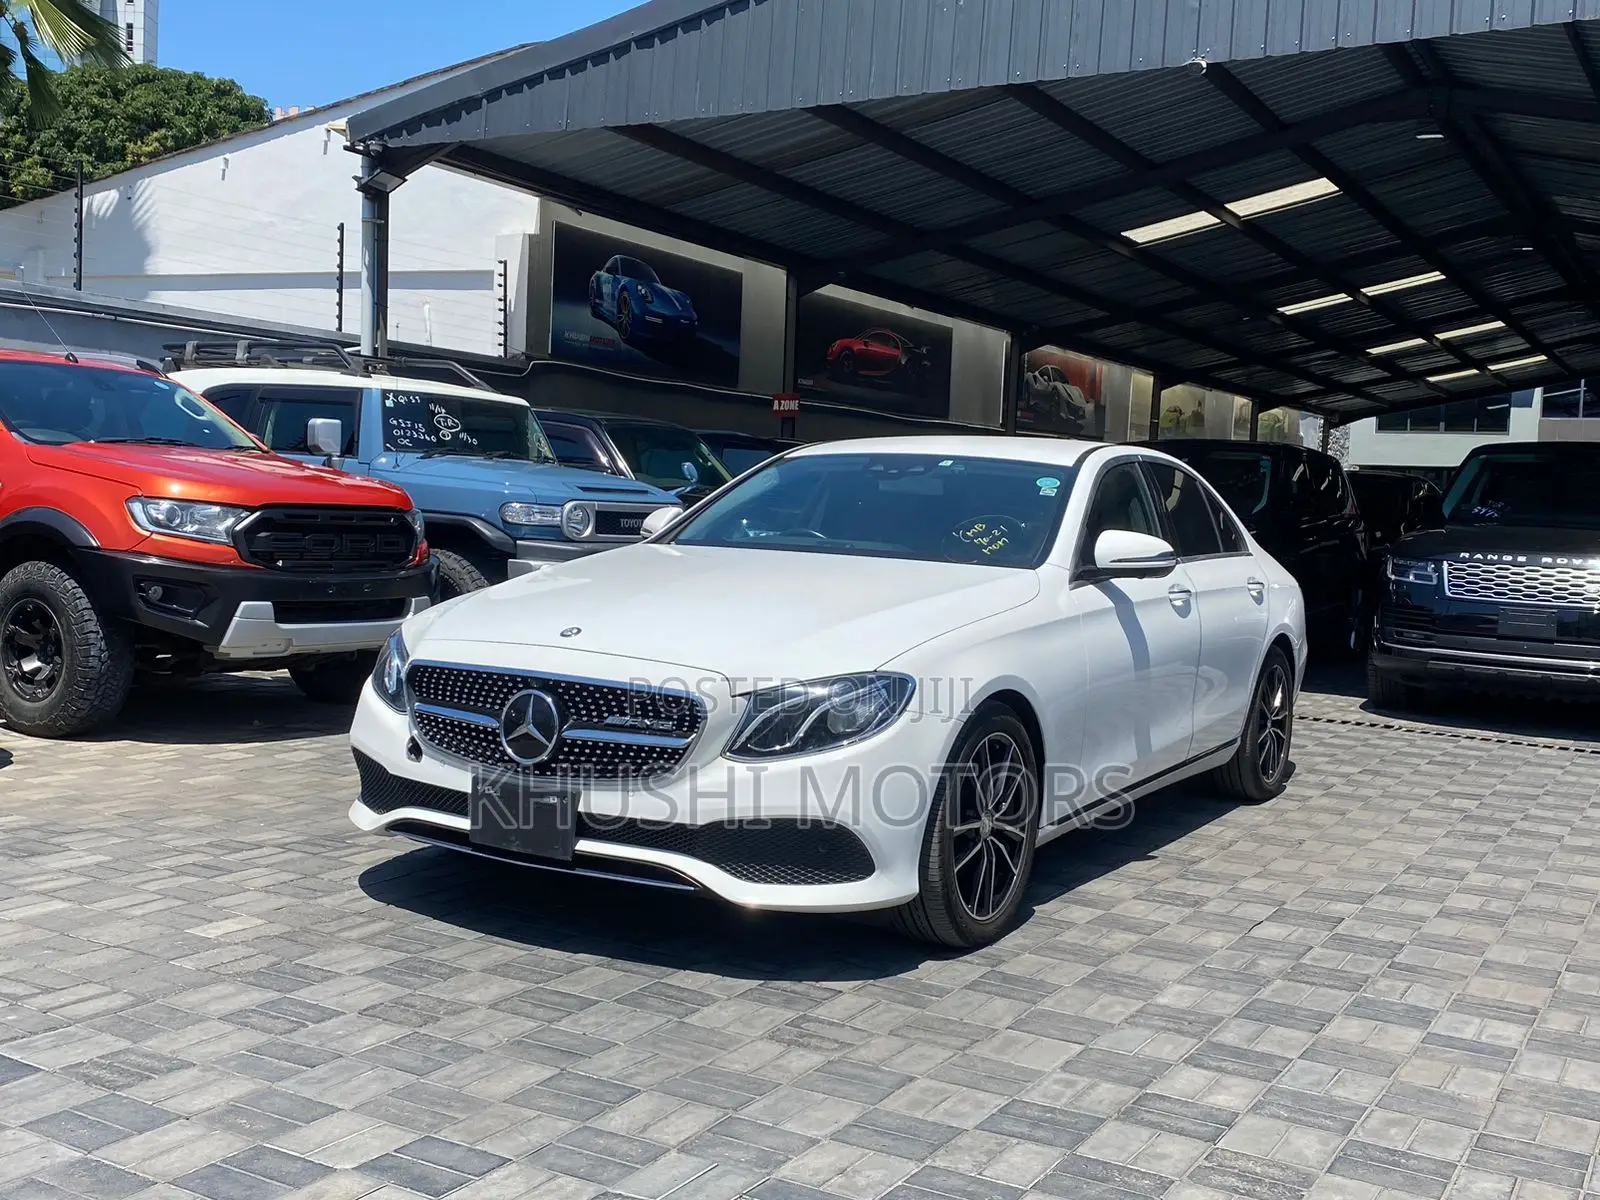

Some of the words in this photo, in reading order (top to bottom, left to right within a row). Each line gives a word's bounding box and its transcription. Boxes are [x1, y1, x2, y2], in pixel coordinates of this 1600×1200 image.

[773, 400, 779, 410] A
[780, 400, 799, 410] ZONE
[620, 518, 643, 528] TOYOT
[1459, 552, 1527, 562] RANGE
[1541, 557, 1600, 566] ROVE
